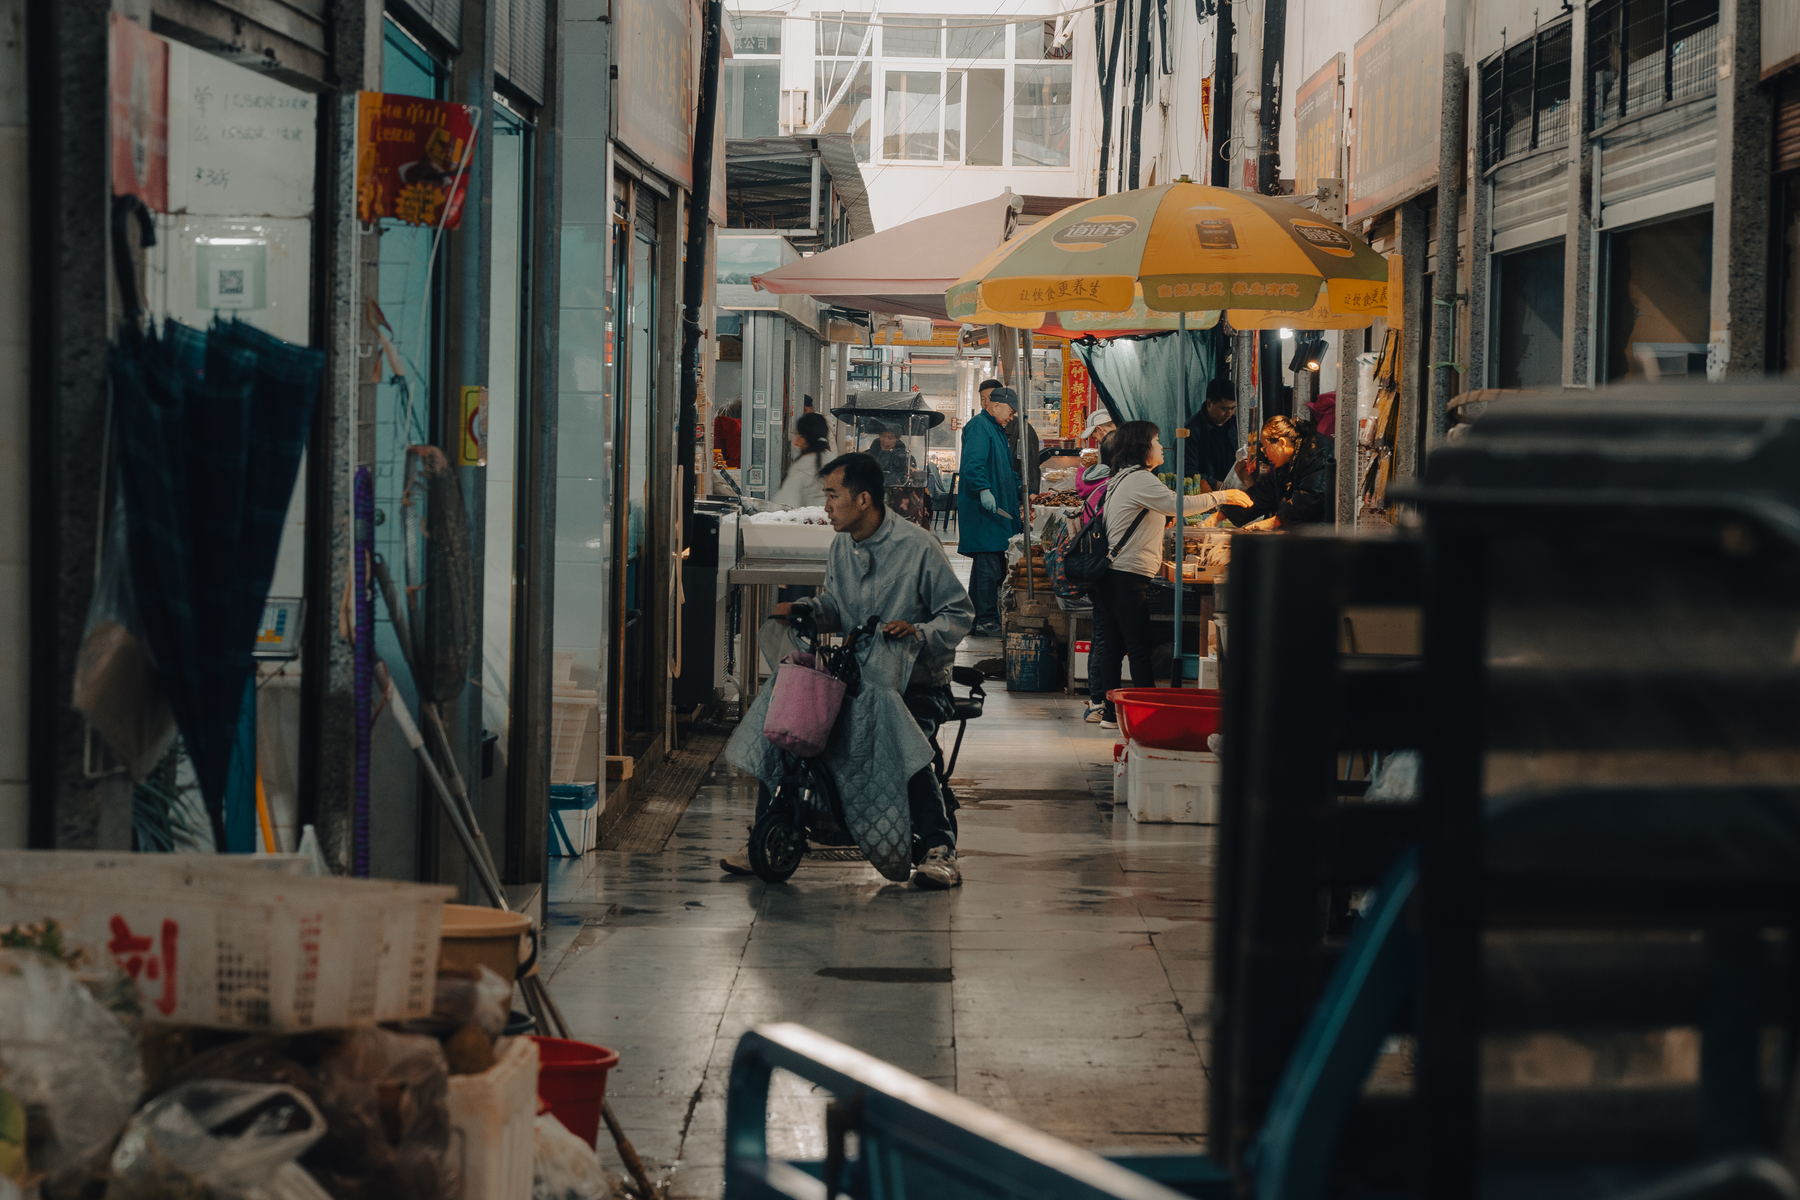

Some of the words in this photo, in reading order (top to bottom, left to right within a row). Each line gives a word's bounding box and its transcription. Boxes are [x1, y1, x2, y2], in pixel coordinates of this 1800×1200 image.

[1063, 223, 1132, 238] 道道全
[1295, 226, 1348, 244] 道道全
[1018, 278, 1101, 302] 让饮食更养生
